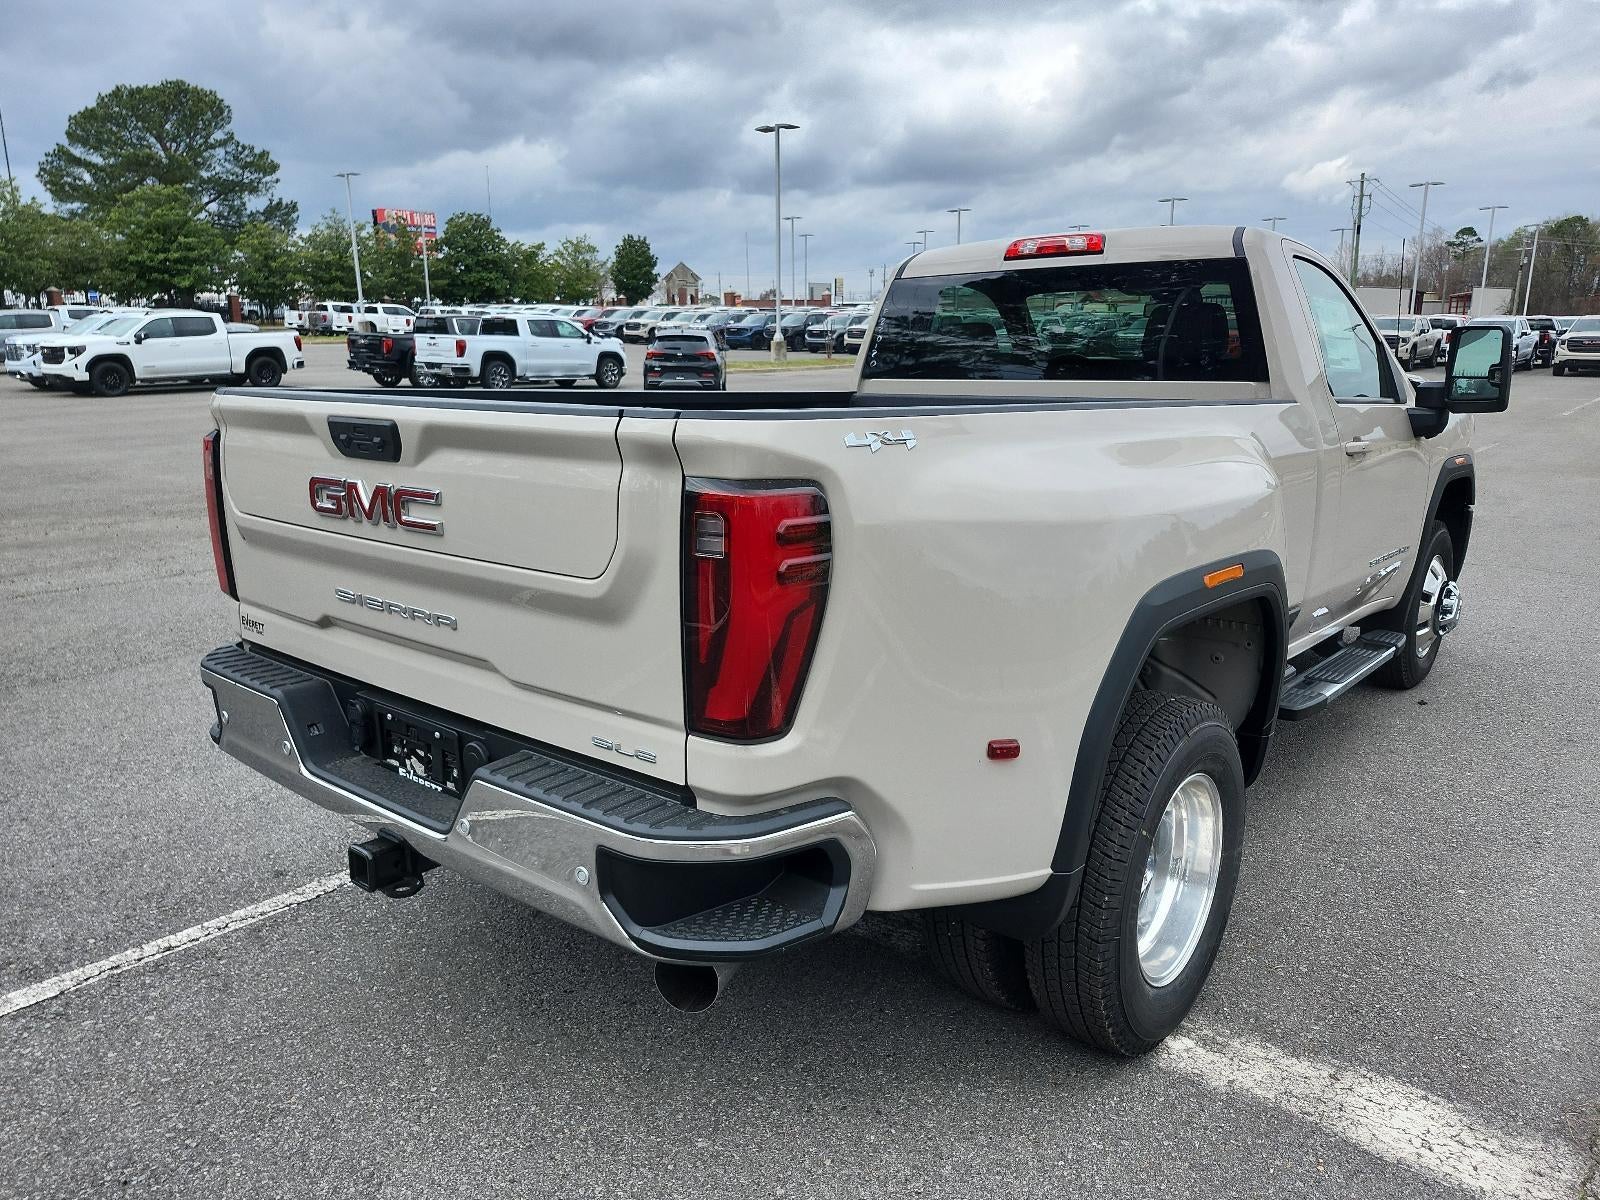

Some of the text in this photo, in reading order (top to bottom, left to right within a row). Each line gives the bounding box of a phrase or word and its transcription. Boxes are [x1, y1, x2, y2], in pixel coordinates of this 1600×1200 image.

[309, 476, 445, 536] GMC
[241, 613, 265, 630] EVERETT
[335, 588, 457, 631] SIERRA
[592, 735, 657, 765] SLE
[398, 767, 443, 792] EVERETT
